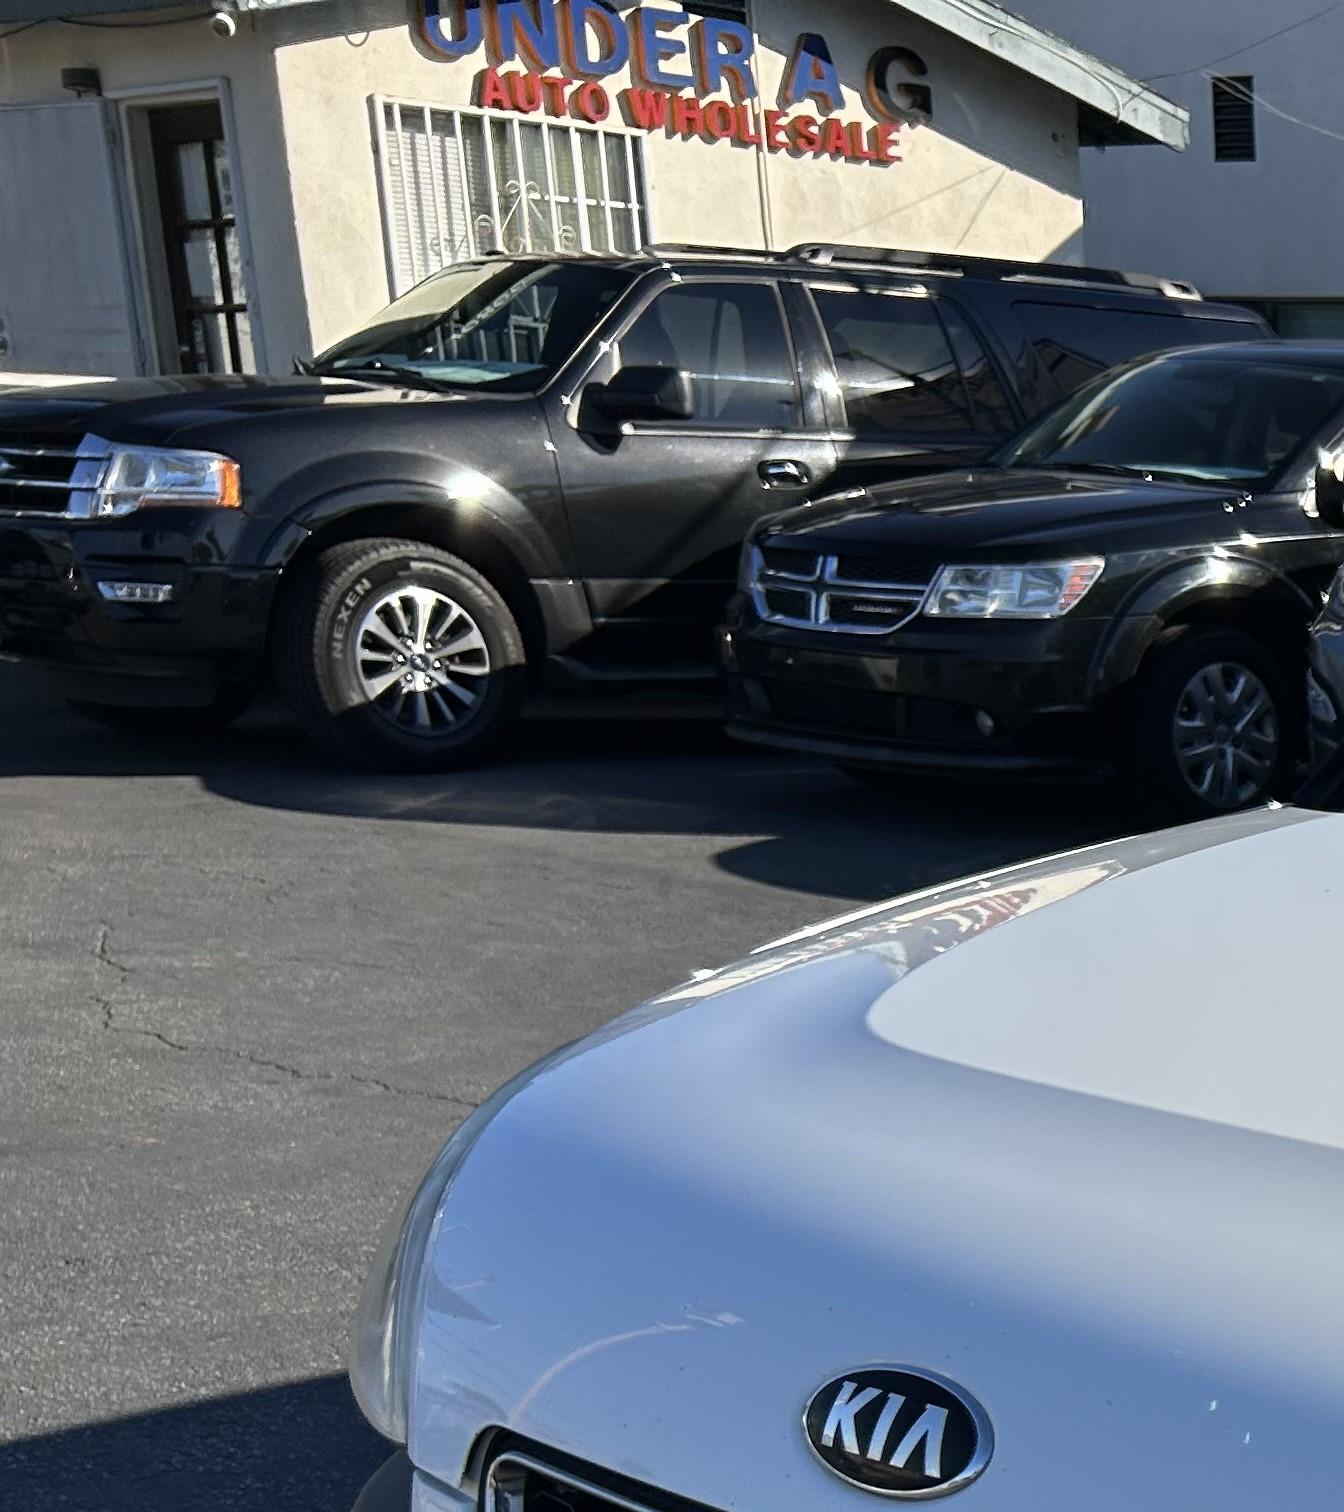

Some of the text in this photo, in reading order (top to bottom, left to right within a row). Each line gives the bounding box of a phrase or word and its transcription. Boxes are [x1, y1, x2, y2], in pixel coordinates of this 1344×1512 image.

[409, 0, 757, 100] UNDER
[470, 67, 903, 168] AUTO WHOLESALE
[333, 578, 372, 659] NEXEN
[820, 1379, 950, 1480] KIA
